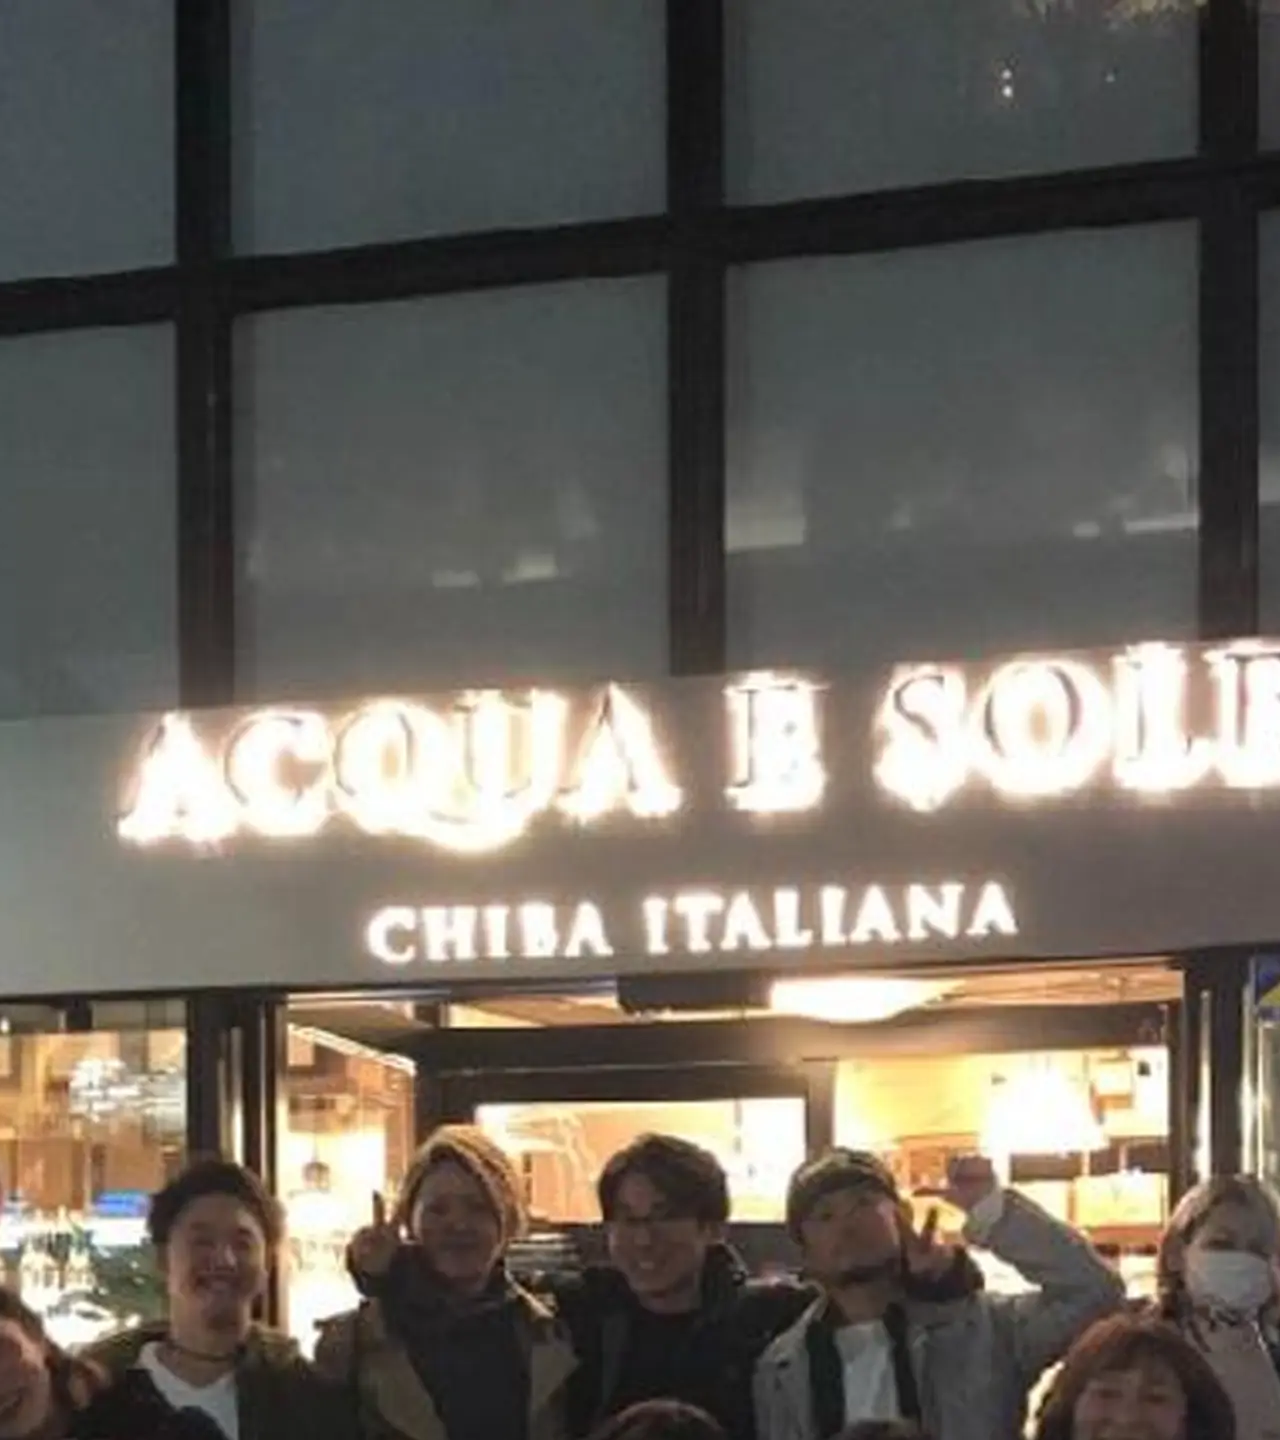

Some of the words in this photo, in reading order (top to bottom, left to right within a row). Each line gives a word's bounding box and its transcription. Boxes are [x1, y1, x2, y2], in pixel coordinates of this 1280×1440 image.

[117, 683, 683, 852] ACQUA
[722, 670, 828, 812] E
[366, 902, 613, 963] CHIBA
[641, 881, 1019, 956] ITALIANA
